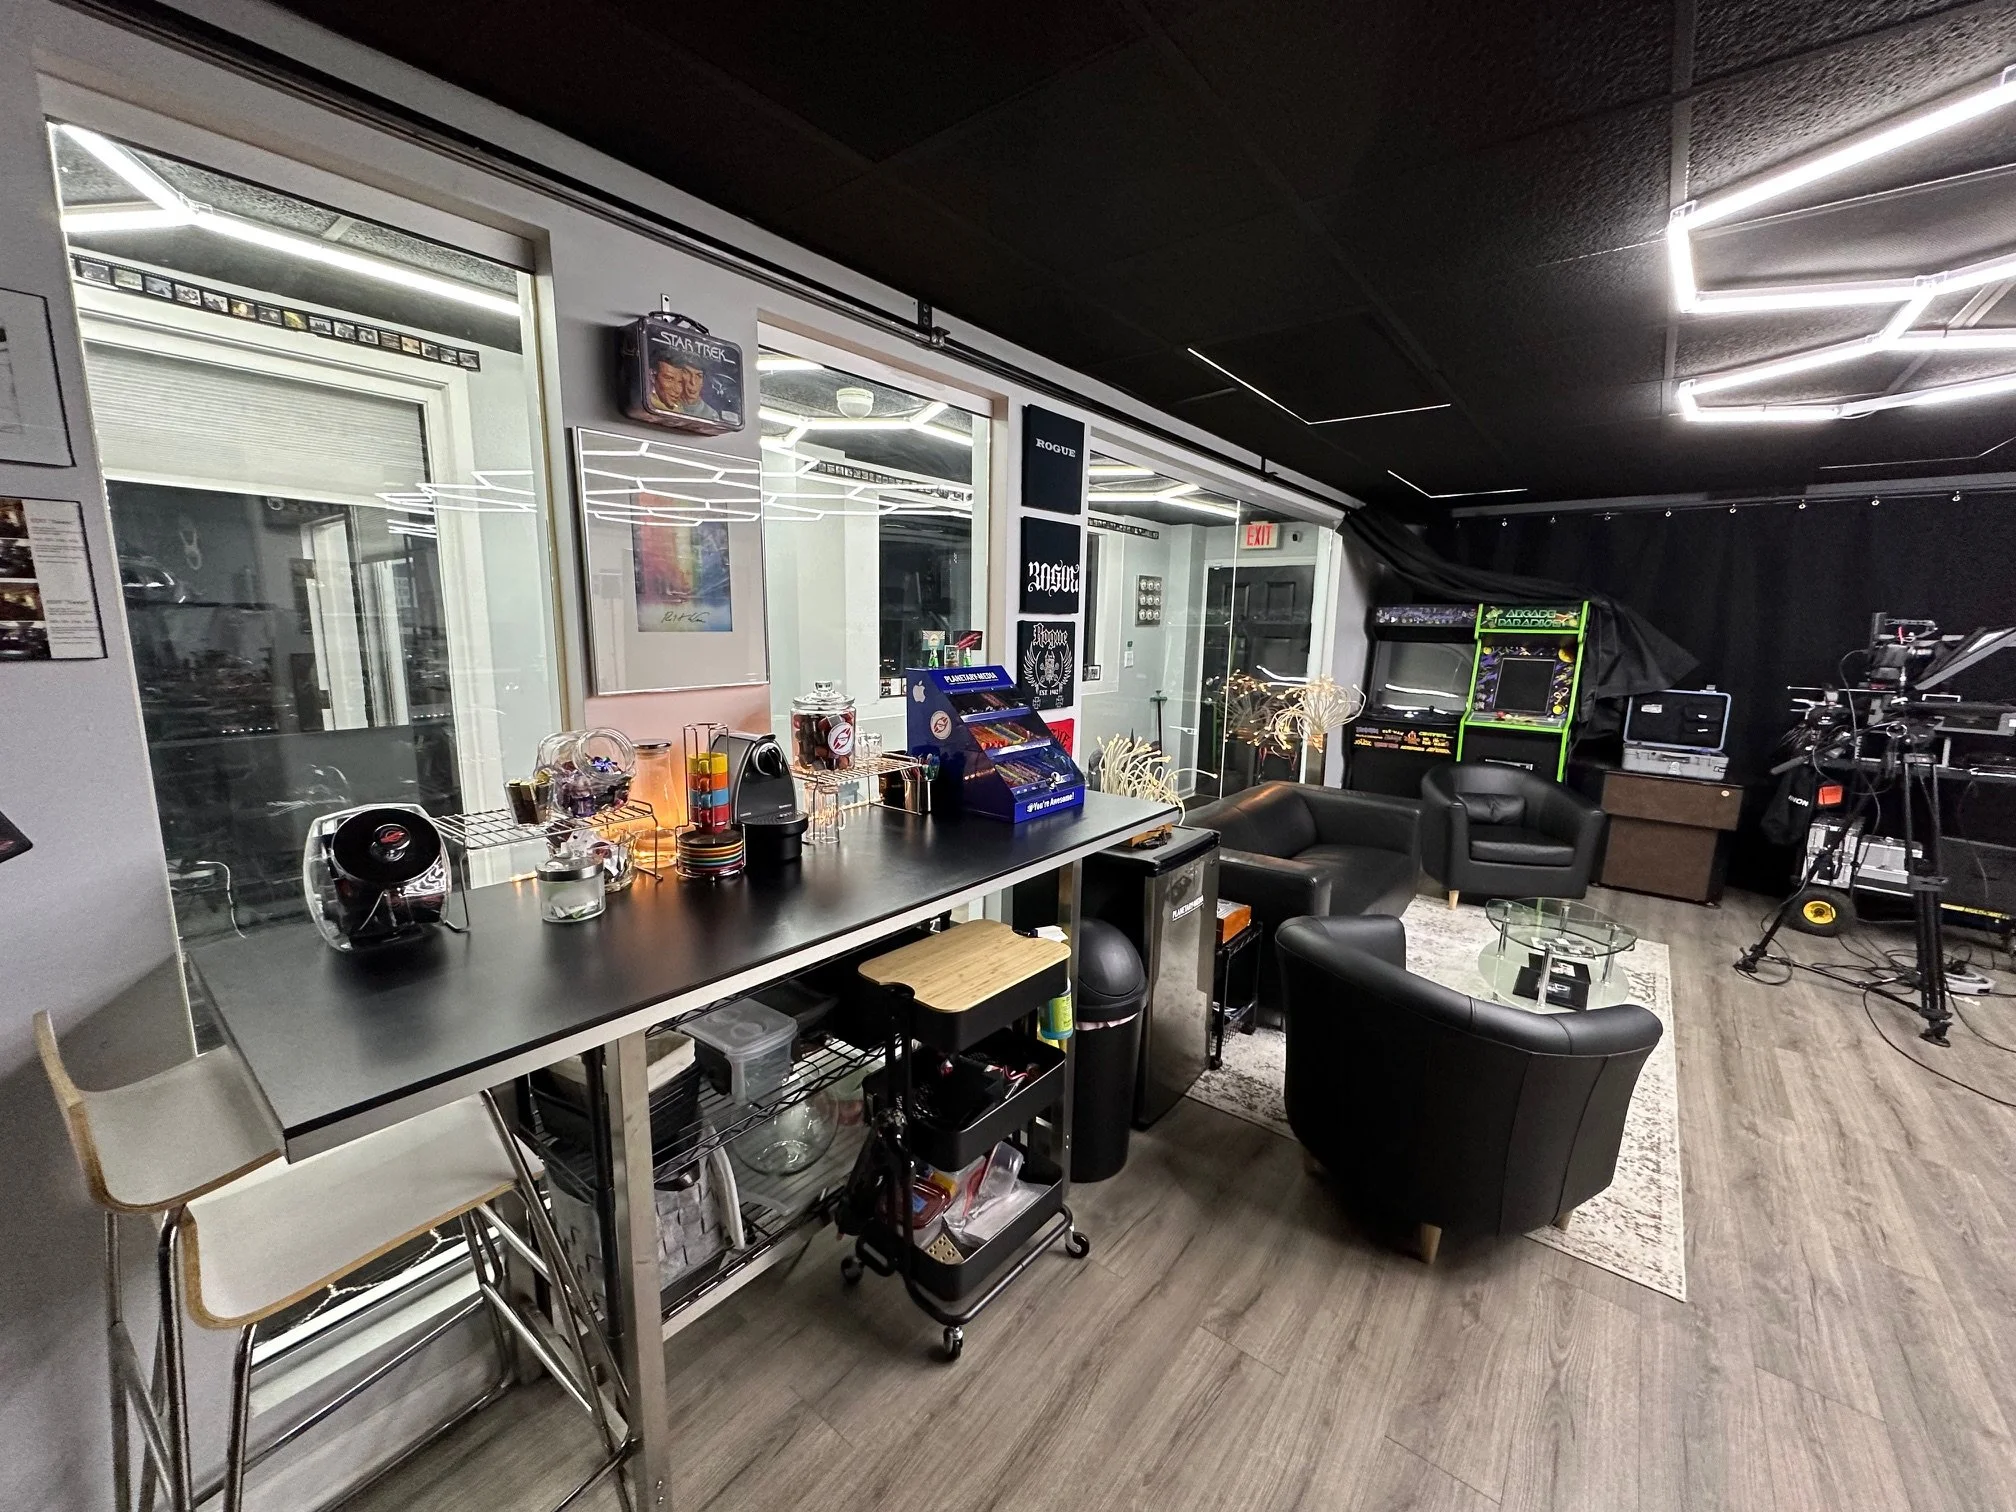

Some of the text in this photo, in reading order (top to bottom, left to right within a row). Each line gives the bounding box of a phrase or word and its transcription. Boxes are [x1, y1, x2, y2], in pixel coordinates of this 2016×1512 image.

[651, 331, 694, 352] STAR
[695, 341, 736, 365] TREK
[1035, 438, 1076, 458] ROGUE
[1246, 524, 1273, 546] EXIT
[1506, 609, 1557, 618] ARCADE
[1033, 622, 1069, 650] Rogue
